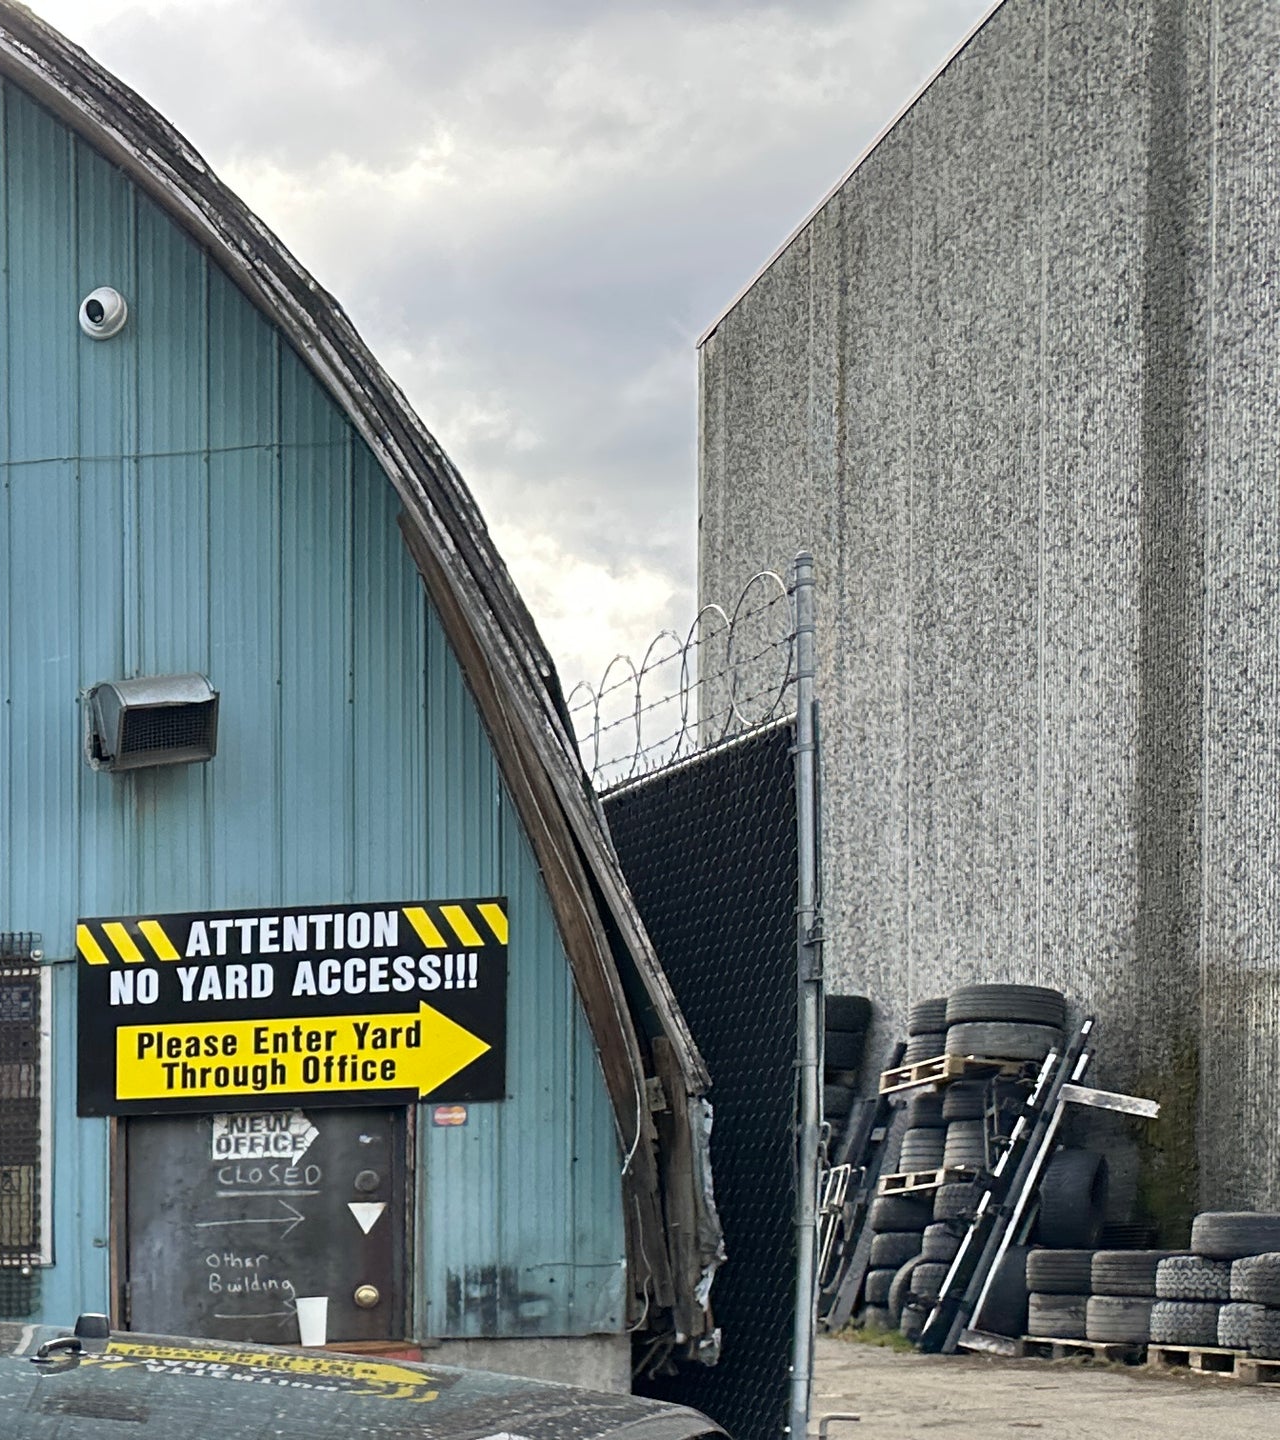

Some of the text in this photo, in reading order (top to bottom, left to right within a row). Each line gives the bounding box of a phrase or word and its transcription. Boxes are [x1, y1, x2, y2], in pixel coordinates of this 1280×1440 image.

[185, 911, 398, 957] ATTENTION
[110, 952, 478, 1005] NO YARD ACCESS!!!
[137, 1020, 421, 1060] Please Enter Yard
[162, 1056, 396, 1091] Through Office
[229, 1113, 290, 1133] NEW
[216, 1133, 306, 1154] OFFICE
[218, 1164, 321, 1185] CLOSED
[206, 1253, 269, 1269] Other
